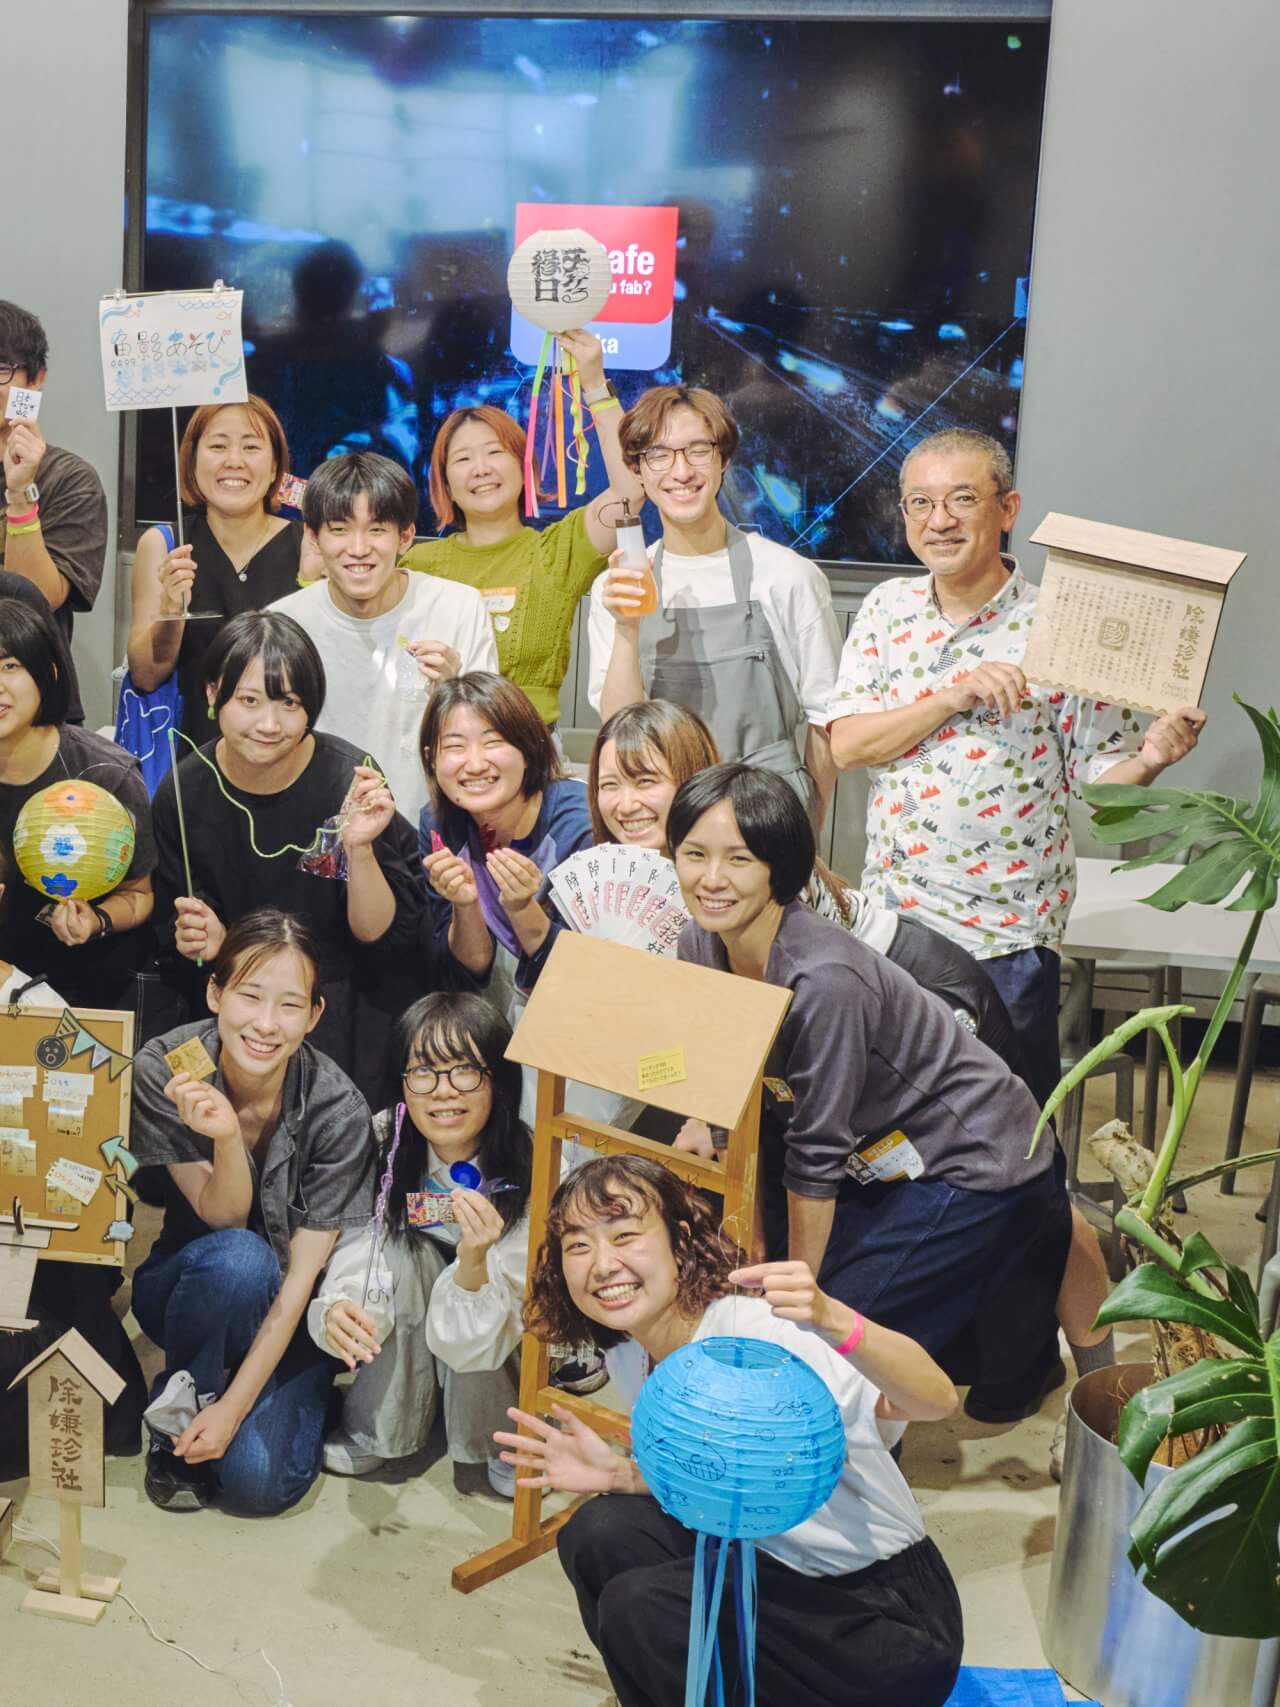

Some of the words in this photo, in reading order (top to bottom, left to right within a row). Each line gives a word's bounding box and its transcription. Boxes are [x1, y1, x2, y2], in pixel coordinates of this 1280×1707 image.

[601, 244, 655, 275] afe
[619, 280, 652, 295] fab?
[48, 1375, 83, 1492] 除嫌珍社
